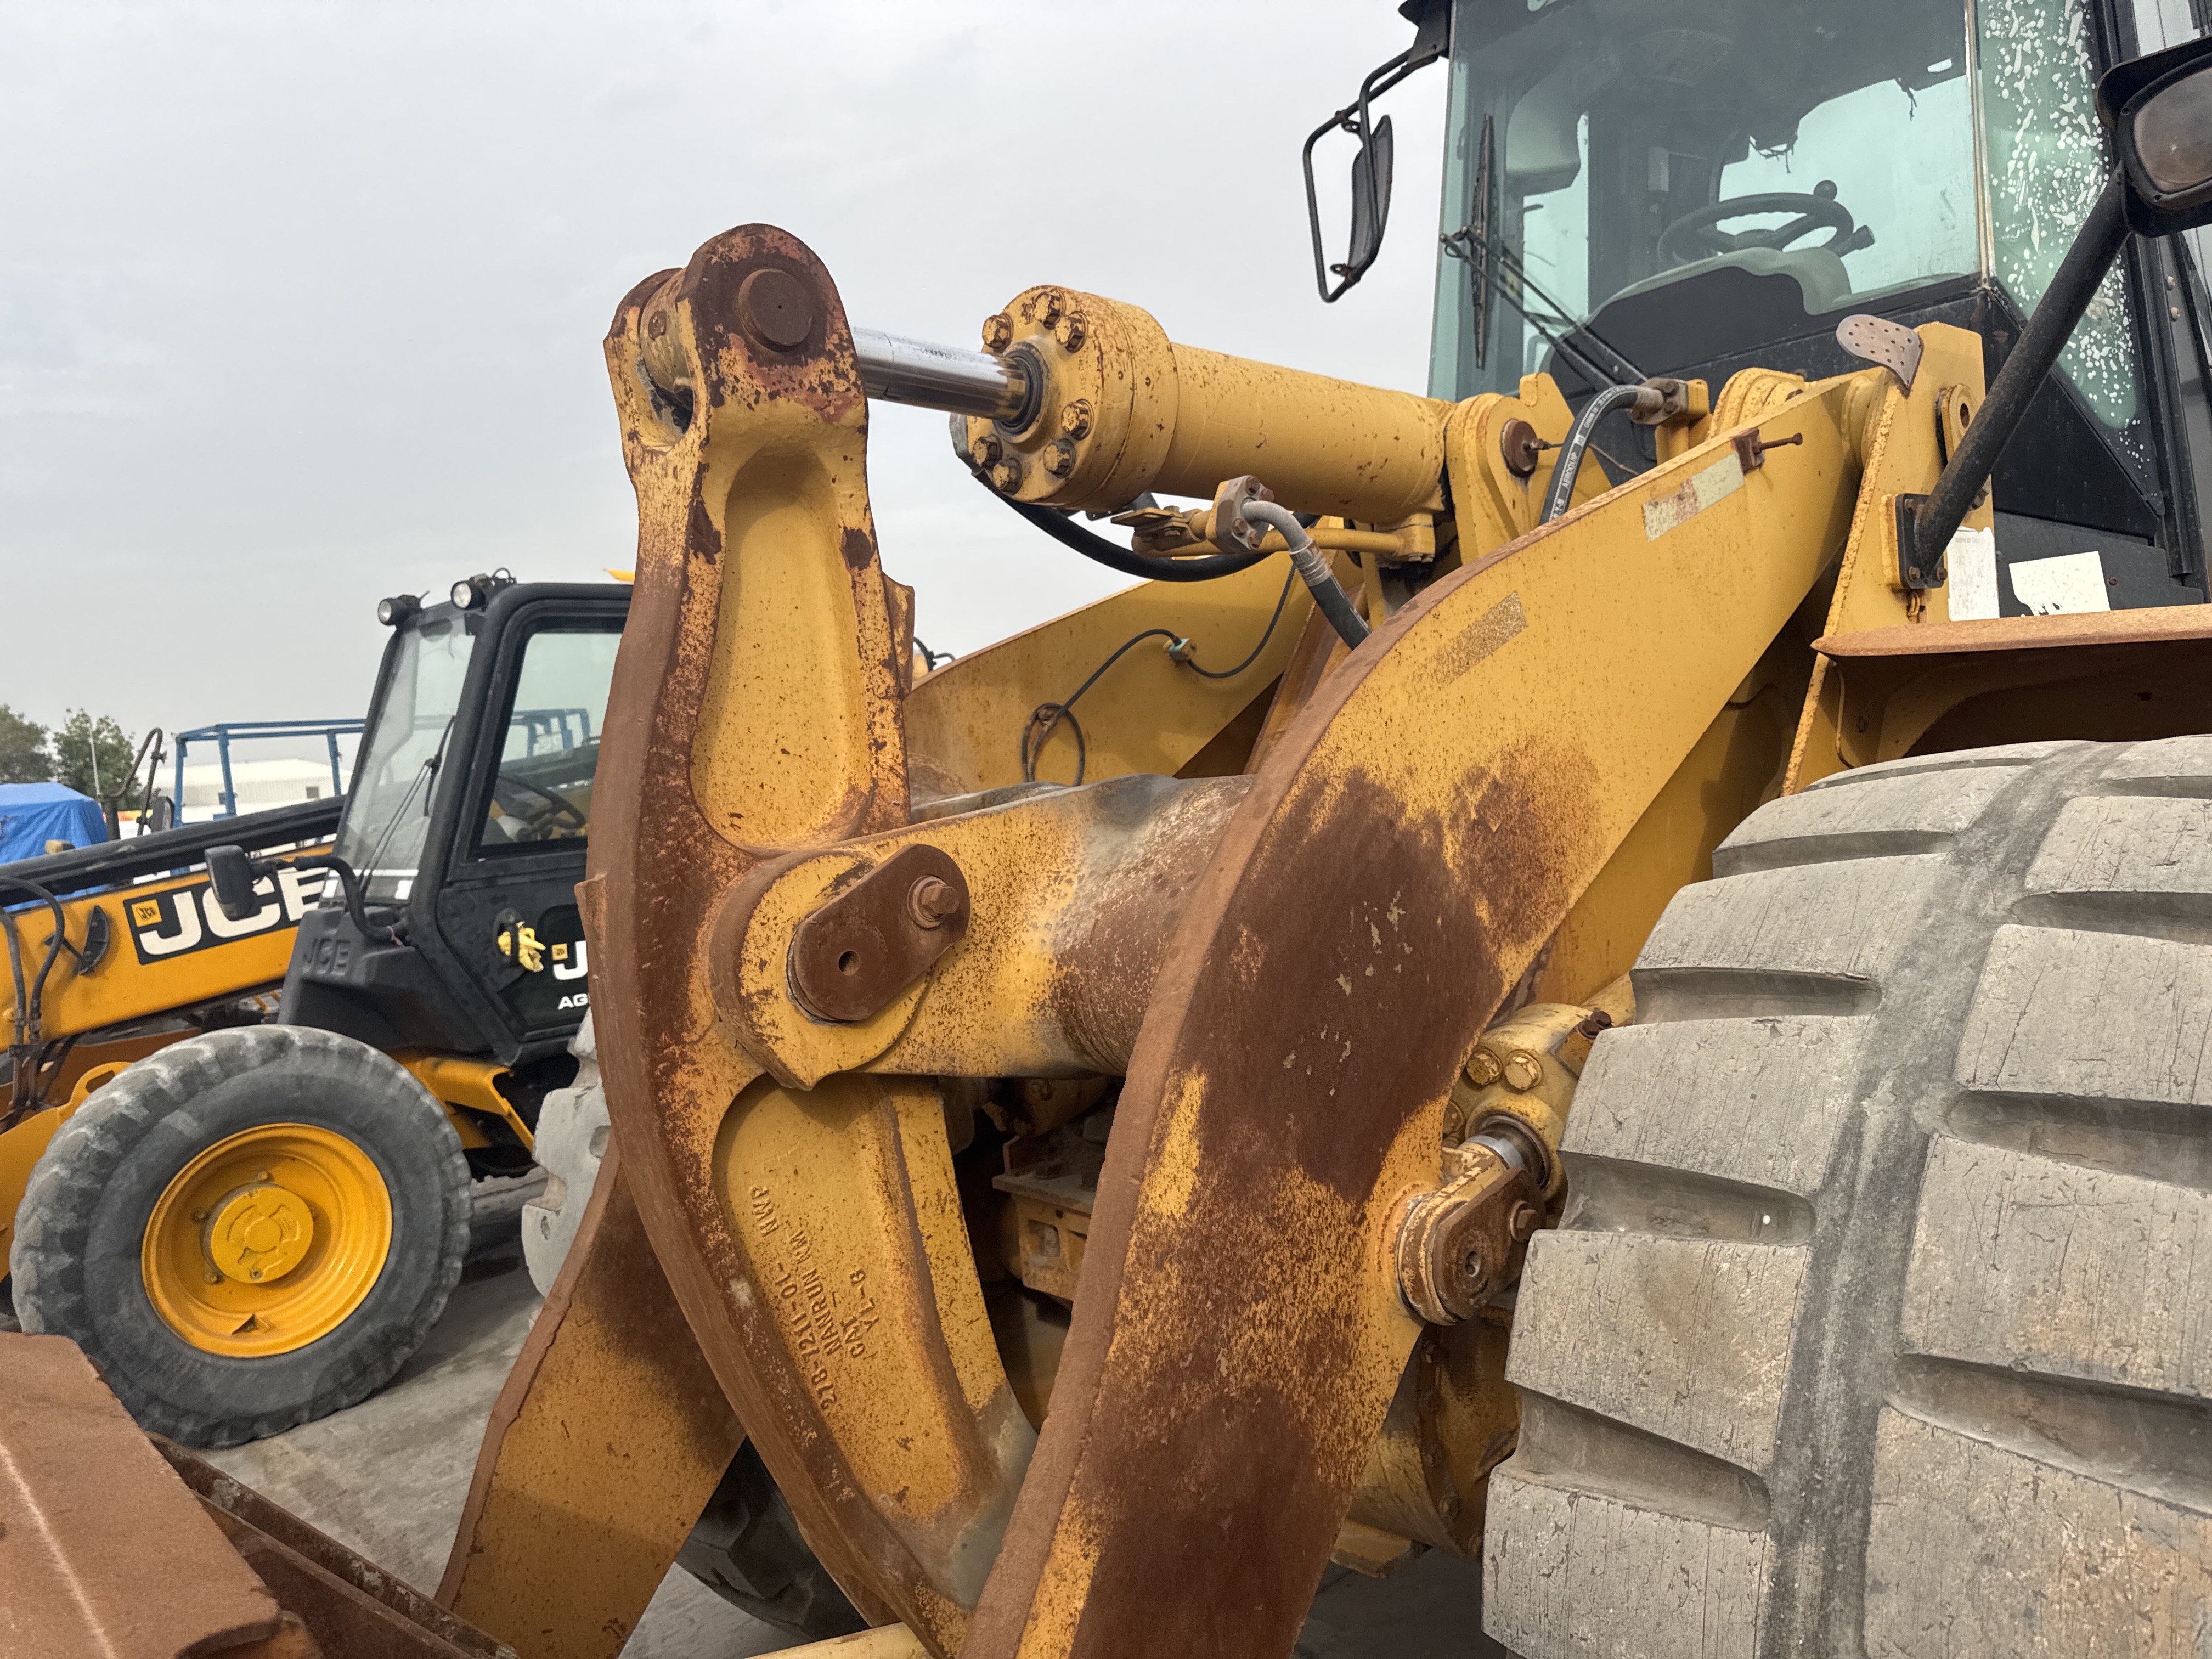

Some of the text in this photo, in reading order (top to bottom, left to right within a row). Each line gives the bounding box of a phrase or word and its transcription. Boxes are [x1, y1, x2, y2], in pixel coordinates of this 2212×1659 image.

[557, 992, 590, 1010] AG
[749, 1184, 779, 1238] NWP
[802, 1268, 843, 1356] NANRUN
[840, 1316, 866, 1359] CAT
